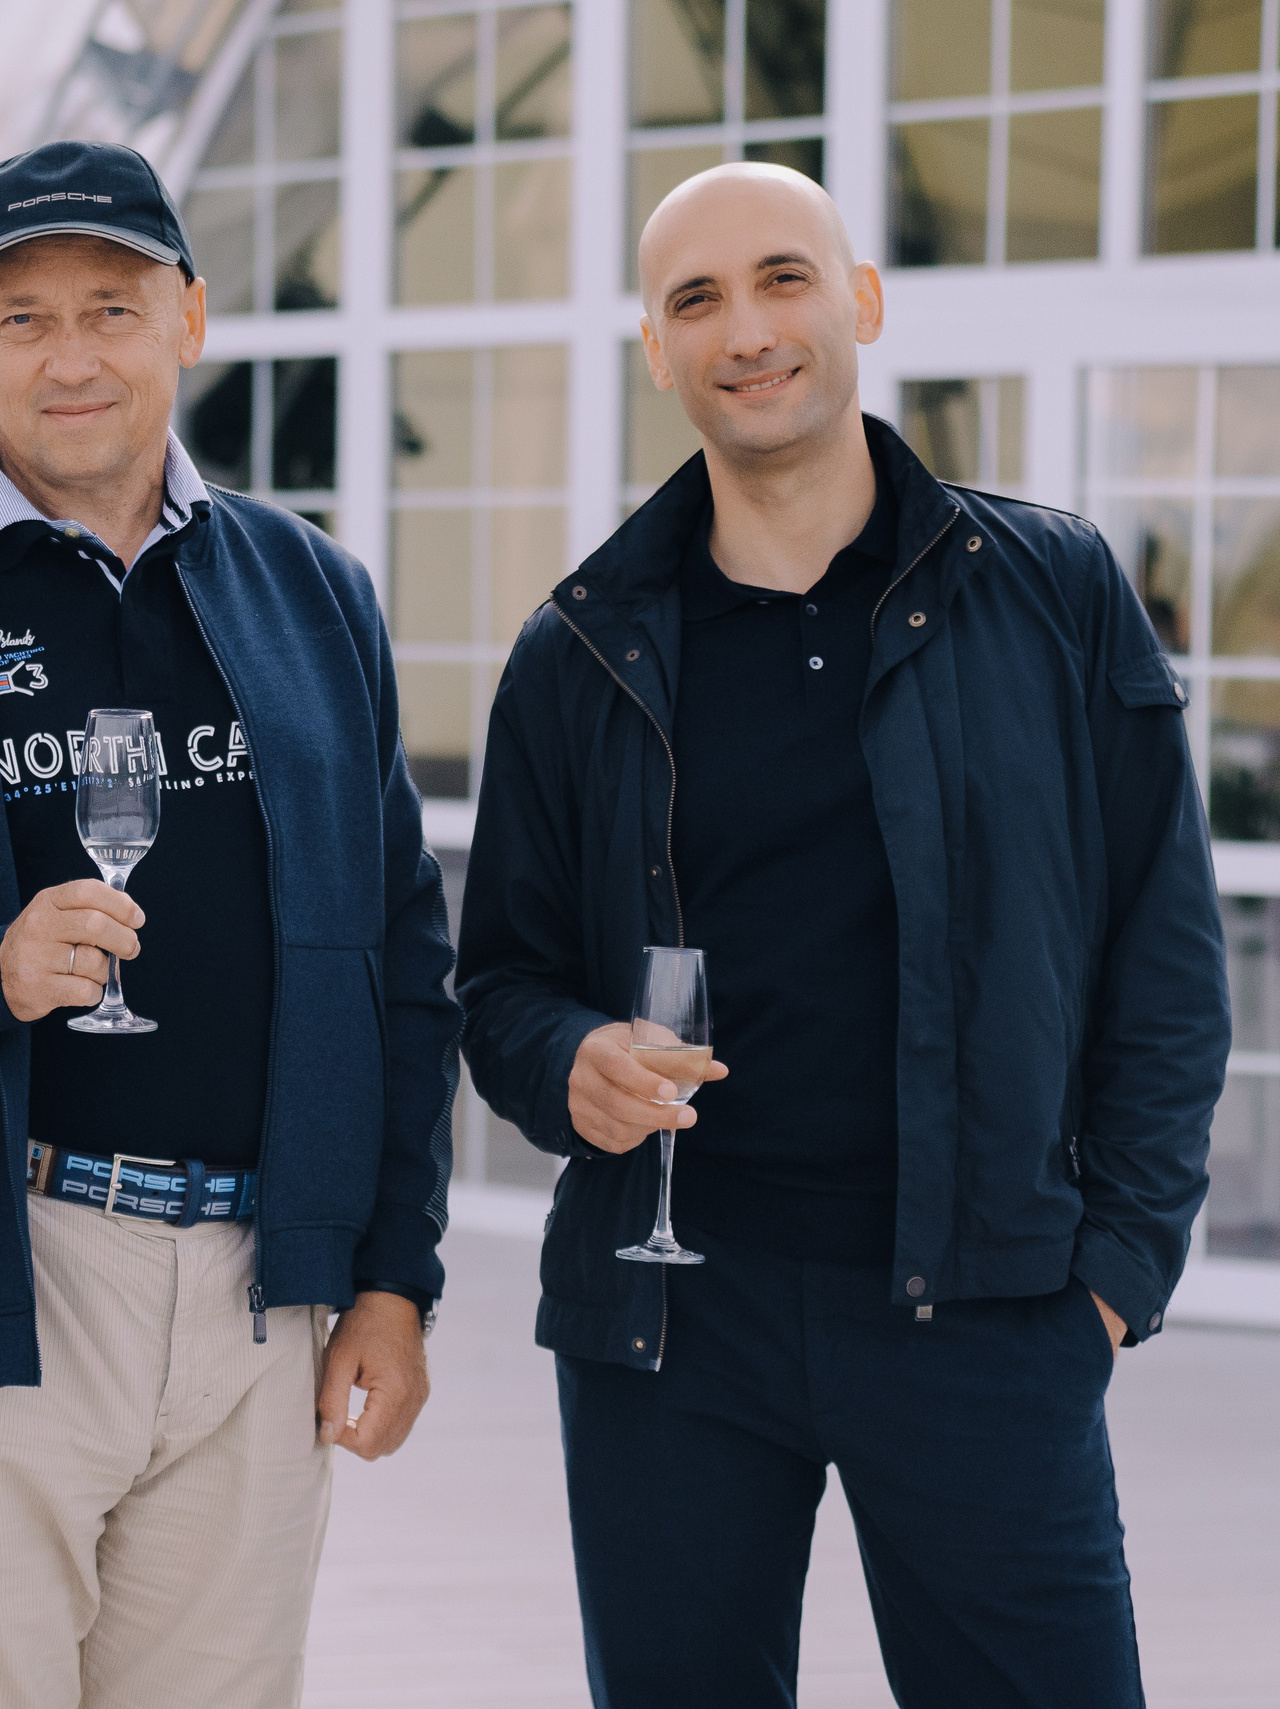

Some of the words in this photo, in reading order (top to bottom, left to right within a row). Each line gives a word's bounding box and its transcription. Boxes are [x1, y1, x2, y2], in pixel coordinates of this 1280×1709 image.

[8, 192, 113, 212] PORSCHE
[4, 646, 45, 660] YACHTING
[25, 664, 49, 689] 3
